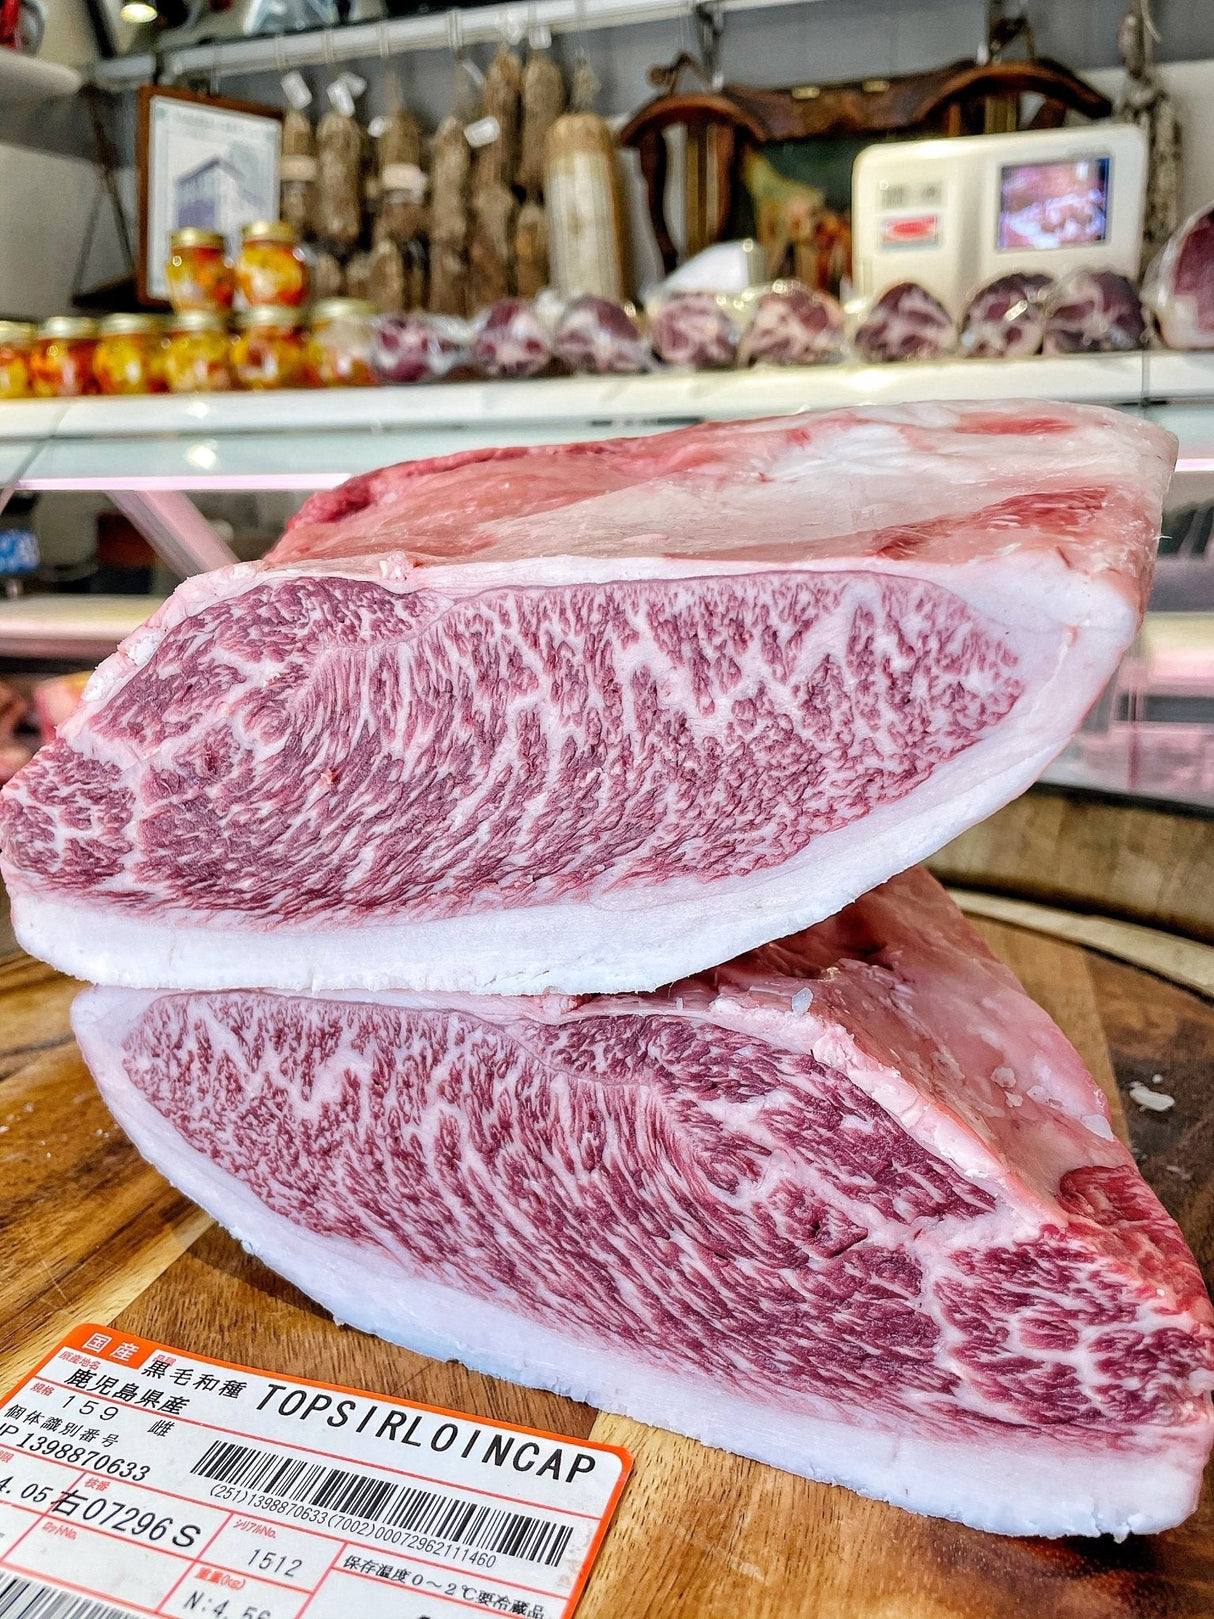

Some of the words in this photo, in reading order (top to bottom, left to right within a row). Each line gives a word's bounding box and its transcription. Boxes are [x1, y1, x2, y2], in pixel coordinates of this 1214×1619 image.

[59, 1350, 101, 1371] 原産地名
[82, 1332, 139, 1361] 国産
[64, 1368, 190, 1415] 鹿児島県産
[4, 1404, 119, 1447] 個体識別番号
[62, 1395, 119, 1421] 159
[147, 1419, 175, 1437] 雌
[141, 1360, 247, 1399] 黒毛和種
[256, 1383, 596, 1484] TOPSIRLOINCAP
[248, 1548, 303, 1578] 1512
